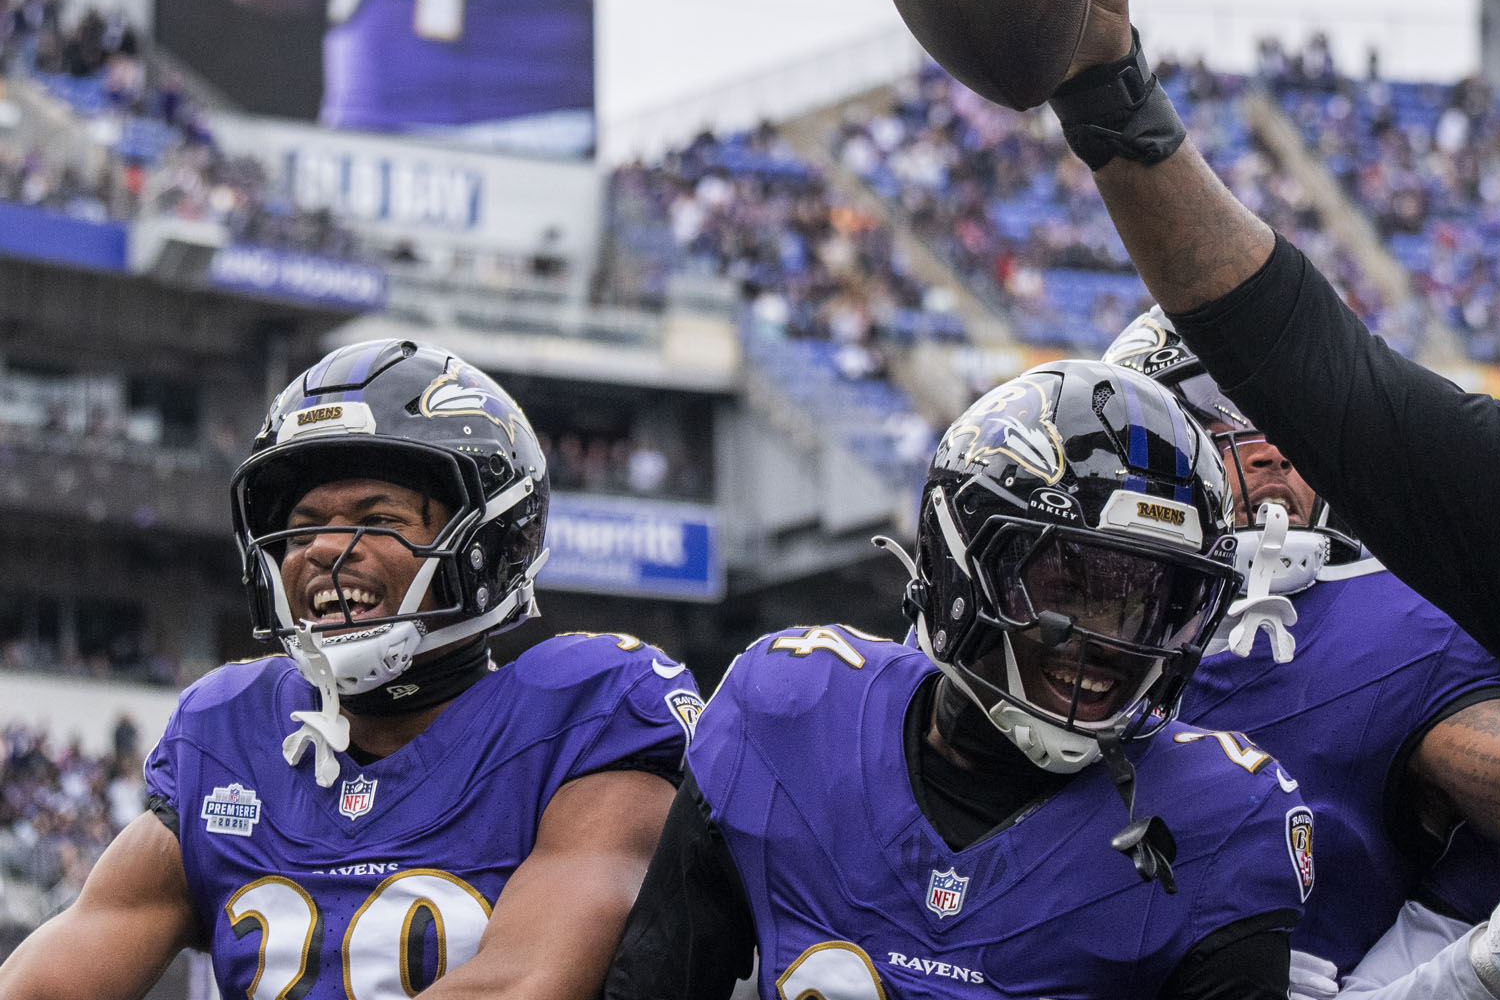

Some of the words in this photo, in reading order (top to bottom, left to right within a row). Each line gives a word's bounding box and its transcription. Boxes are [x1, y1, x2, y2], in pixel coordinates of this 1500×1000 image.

[297, 406, 343, 426] RAVENS
[1030, 500, 1078, 521] OAKLEY
[1137, 502, 1186, 526] RAVENS
[207, 801, 256, 818] PREM1ERE
[344, 795, 367, 812] NFL
[931, 889, 957, 910] NFL
[888, 952, 985, 984] RAVENS
